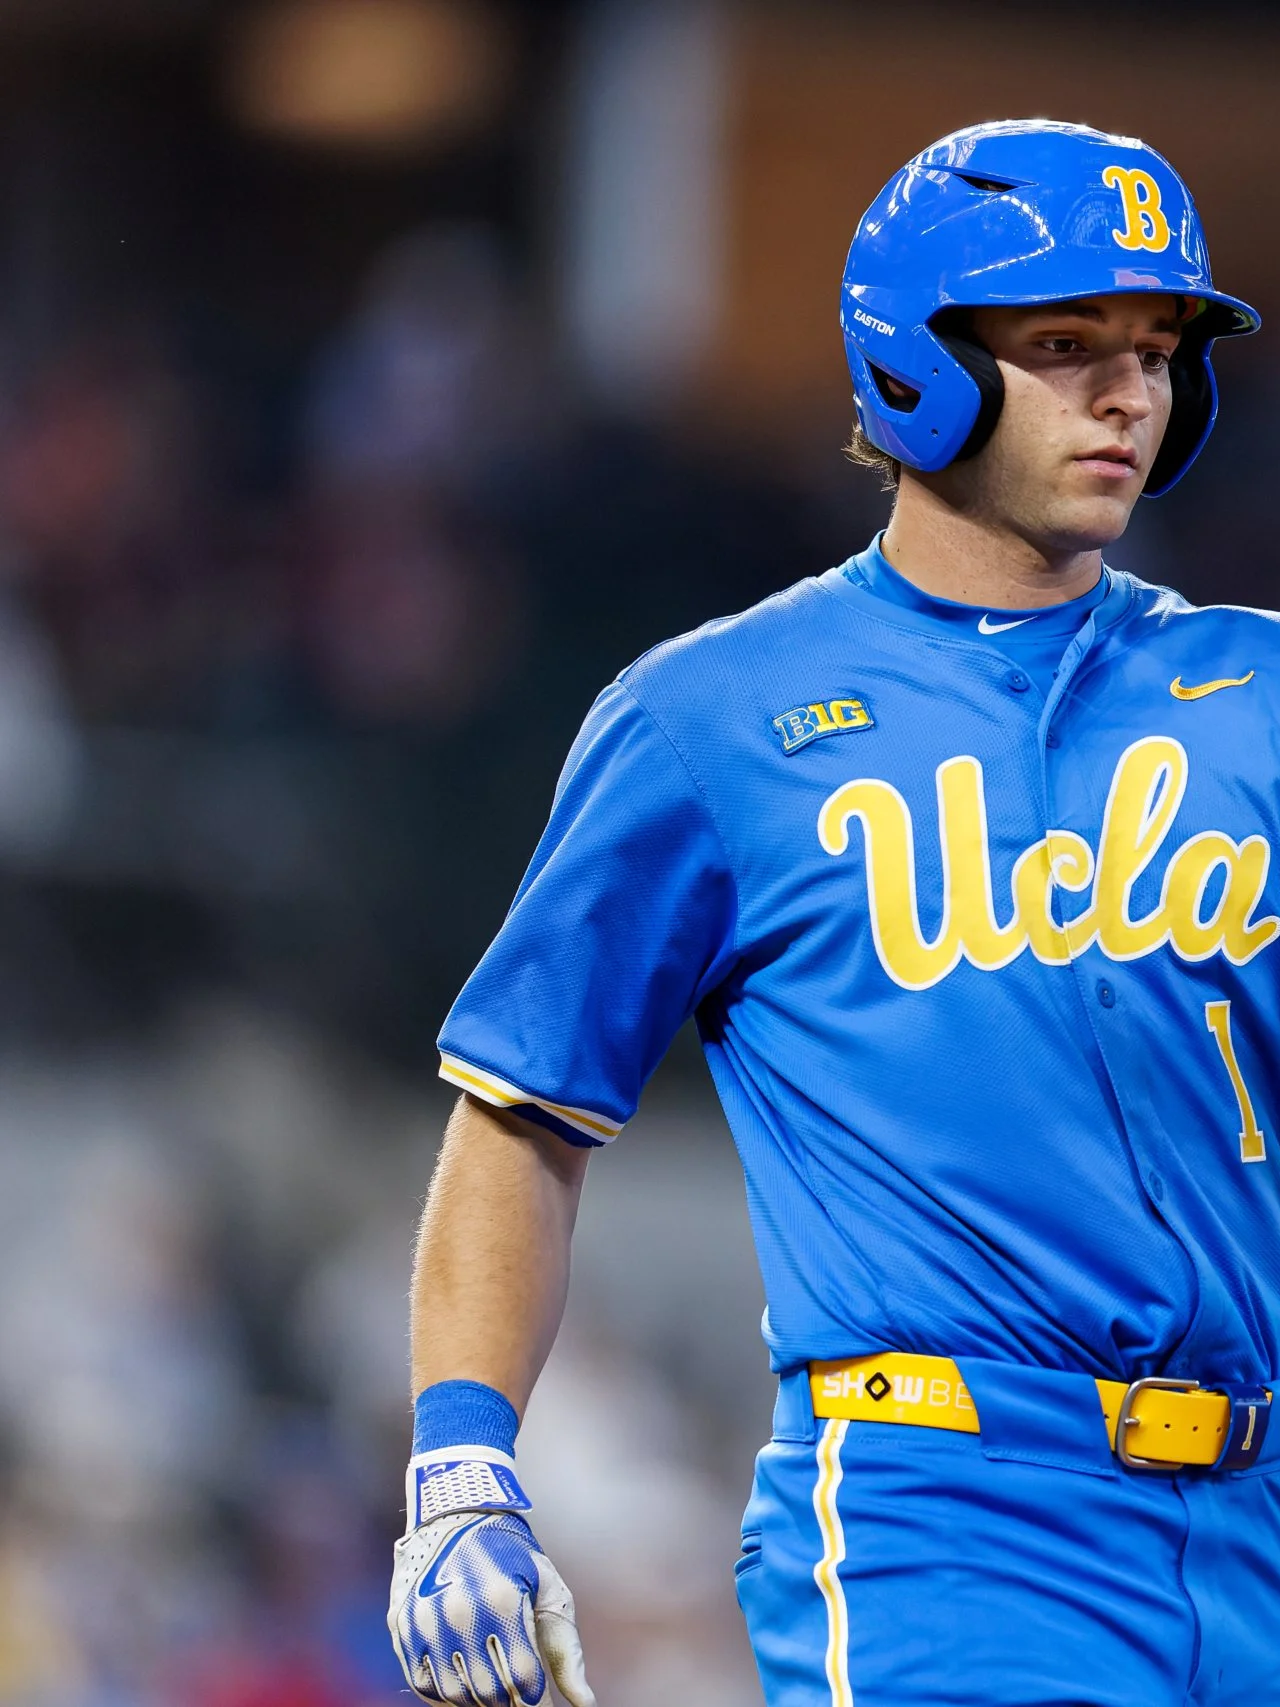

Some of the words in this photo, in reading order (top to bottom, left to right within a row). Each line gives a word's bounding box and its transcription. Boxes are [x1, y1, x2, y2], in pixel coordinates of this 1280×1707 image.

[1102, 165, 1170, 253] B
[853, 308, 896, 337] EASTON
[1205, 1000, 1266, 1164] 1
[1241, 1405, 1256, 1451] 1
